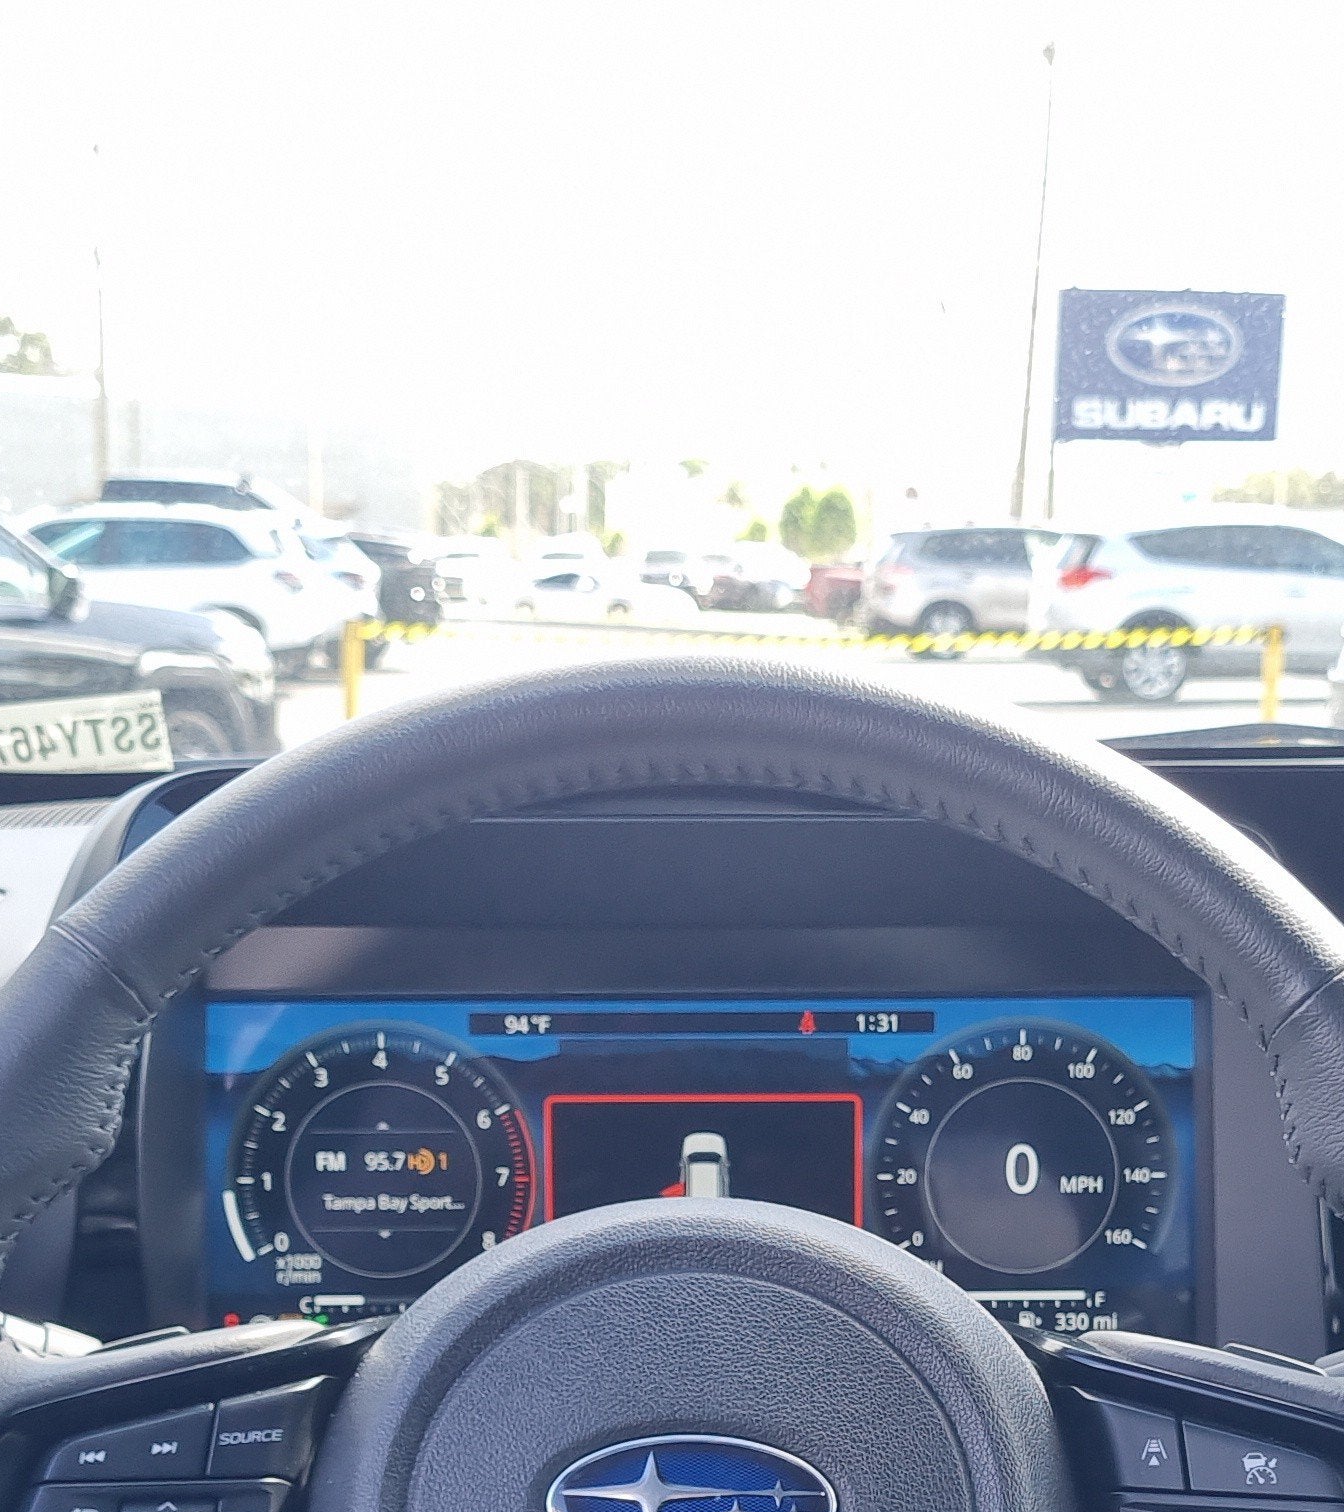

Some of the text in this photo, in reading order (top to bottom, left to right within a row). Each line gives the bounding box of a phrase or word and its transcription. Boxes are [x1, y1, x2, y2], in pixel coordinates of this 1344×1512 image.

[1071, 395, 1268, 432] SUBARU
[503, 1014, 552, 1034] 94°F
[856, 1013, 899, 1032] 1:31
[371, 1050, 388, 1069] 4
[1012, 1045, 1032, 1061] 80
[313, 1068, 330, 1088] 3
[435, 1066, 450, 1086] 5
[953, 1063, 973, 1079] 60
[1068, 1062, 1095, 1079] 100
[271, 1111, 287, 1131] 2
[477, 1109, 492, 1129] 6
[909, 1108, 930, 1125] 40
[1108, 1108, 1136, 1125] 120
[315, 1151, 347, 1172] FM
[364, 1151, 406, 1172] 95.7
[1005, 1143, 1103, 1195] 0 MPH
[261, 1172, 272, 1190] 1
[495, 1168, 509, 1187] 7
[897, 1168, 917, 1185] 20
[1124, 1167, 1150, 1184] 140
[322, 1193, 376, 1213] Tampa
[377, 1193, 407, 1213] Bay
[273, 1232, 290, 1252] 0
[482, 1231, 496, 1251] 8
[912, 1231, 924, 1247] 0
[1104, 1229, 1133, 1246] 160
[1094, 1291, 1106, 1308] F
[1055, 1311, 1118, 1331] 330 mi
[219, 1429, 284, 1446] SOURCE
